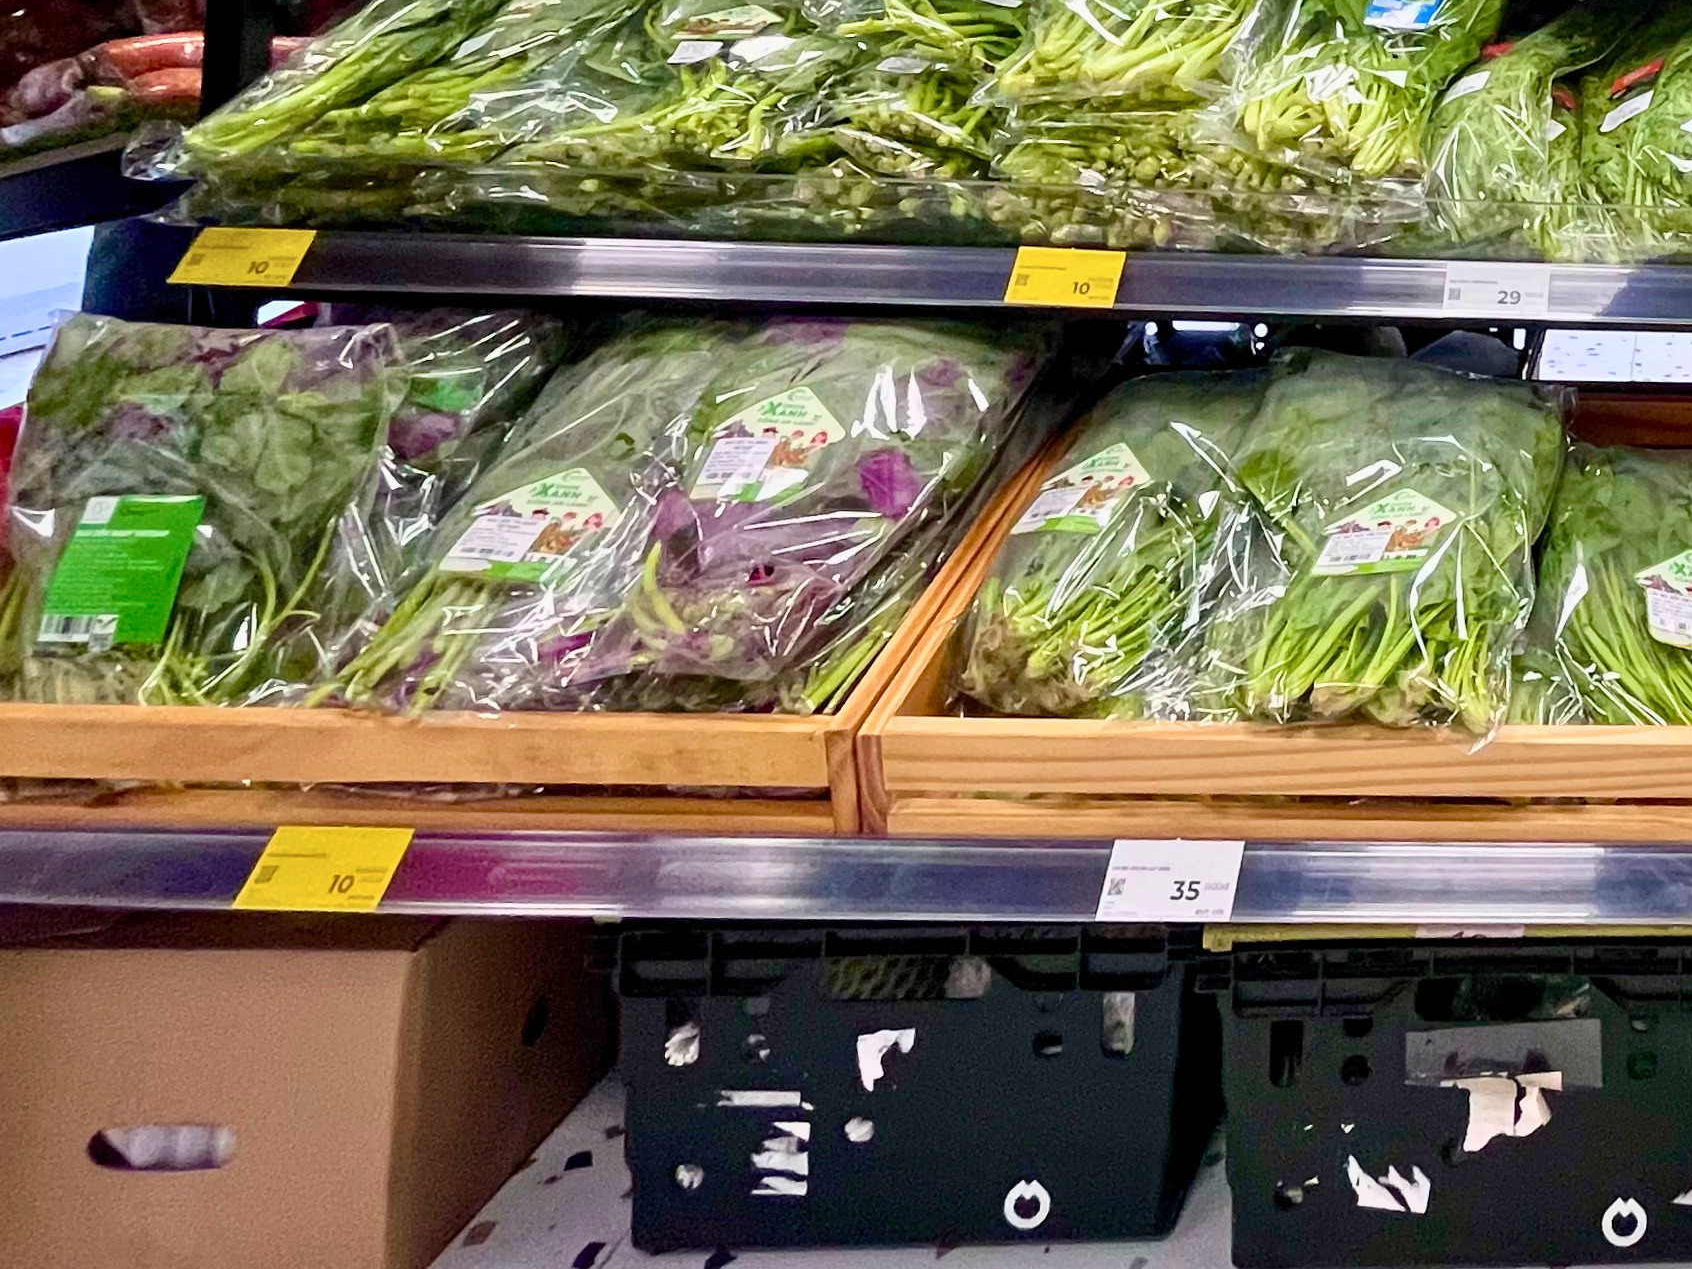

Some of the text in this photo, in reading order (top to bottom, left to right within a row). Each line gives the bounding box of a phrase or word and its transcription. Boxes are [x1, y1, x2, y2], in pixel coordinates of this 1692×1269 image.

[247, 260, 269, 275] 10
[1072, 281, 1090, 295] 10
[1497, 290, 1521, 305] 29
[327, 874, 356, 894] 10
[1169, 880, 1201, 901] 35
